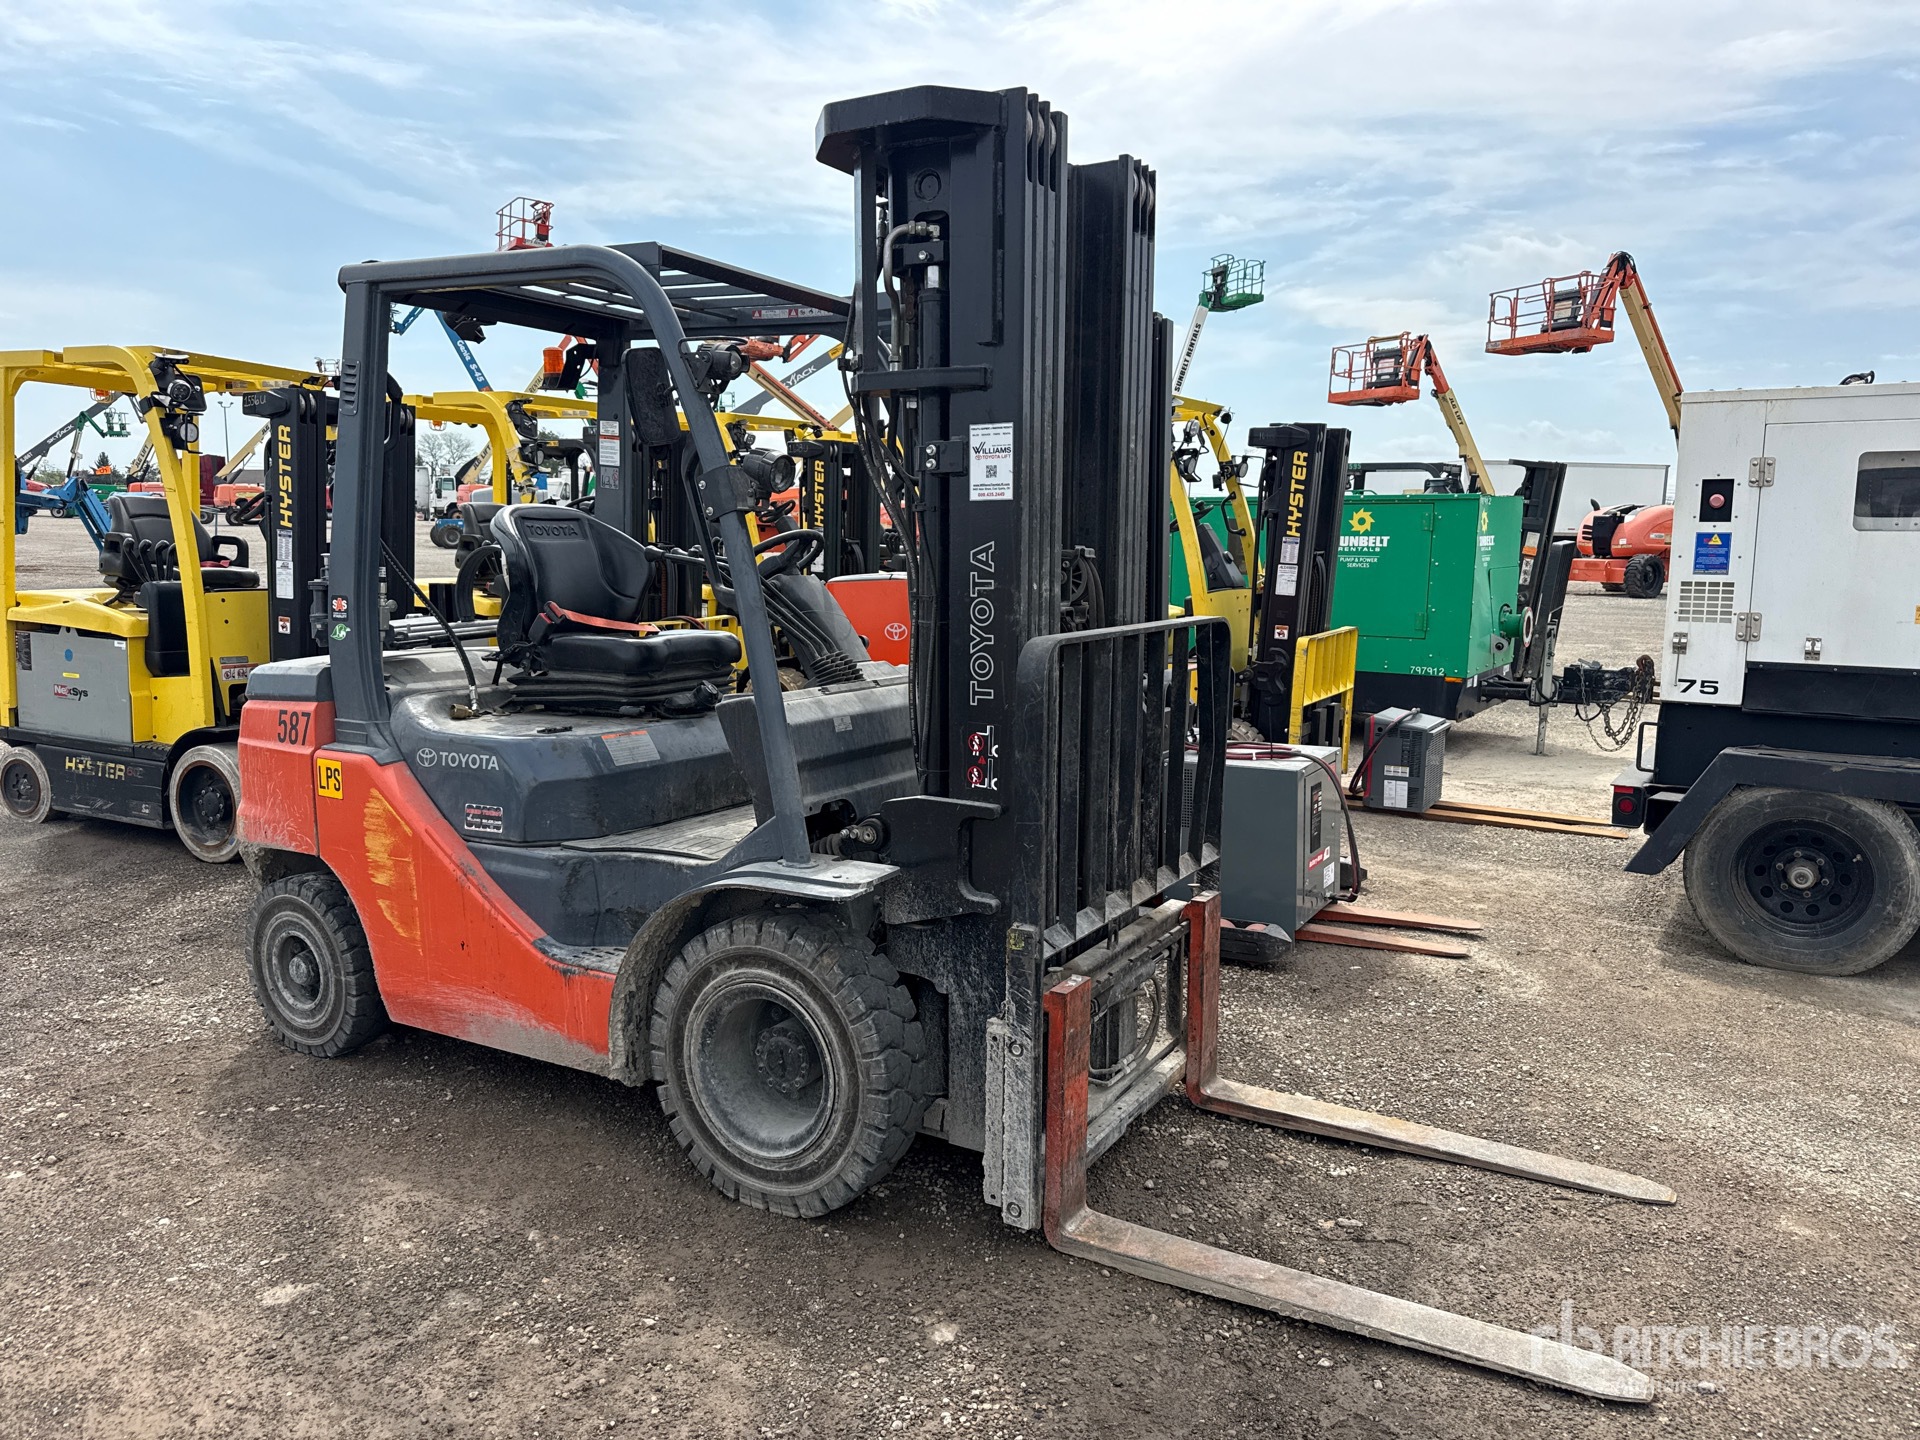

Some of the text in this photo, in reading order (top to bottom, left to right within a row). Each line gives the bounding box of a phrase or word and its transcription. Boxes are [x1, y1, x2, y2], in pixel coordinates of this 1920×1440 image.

[457, 340, 485, 383] Genie S-45
[1174, 322, 1202, 393] SUNBELT RENTALS
[1448, 396, 1465, 425] JLG LIFT
[46, 424, 75, 444] SKYJACK
[139, 444, 149, 458] LIFT
[473, 444, 492, 471] JLG LIFT
[972, 441, 1012, 455] WILLIAMS
[277, 424, 293, 528] HYSTER
[814, 460, 825, 527] HYSTER
[1286, 450, 1308, 537] HYSTER
[526, 524, 578, 537] TOYOTA
[1339, 535, 1391, 547] UNBELT
[332, 597, 348, 611] SAS
[969, 540, 995, 706] TOYOTA
[1410, 665, 1445, 676] 797912
[54, 684, 89, 701] NexSys
[1677, 678, 1719, 695] 75
[277, 709, 312, 746] 587
[65, 756, 126, 781] HYSTER
[439, 751, 500, 771] TOYOTA
[318, 765, 341, 792] LPS
